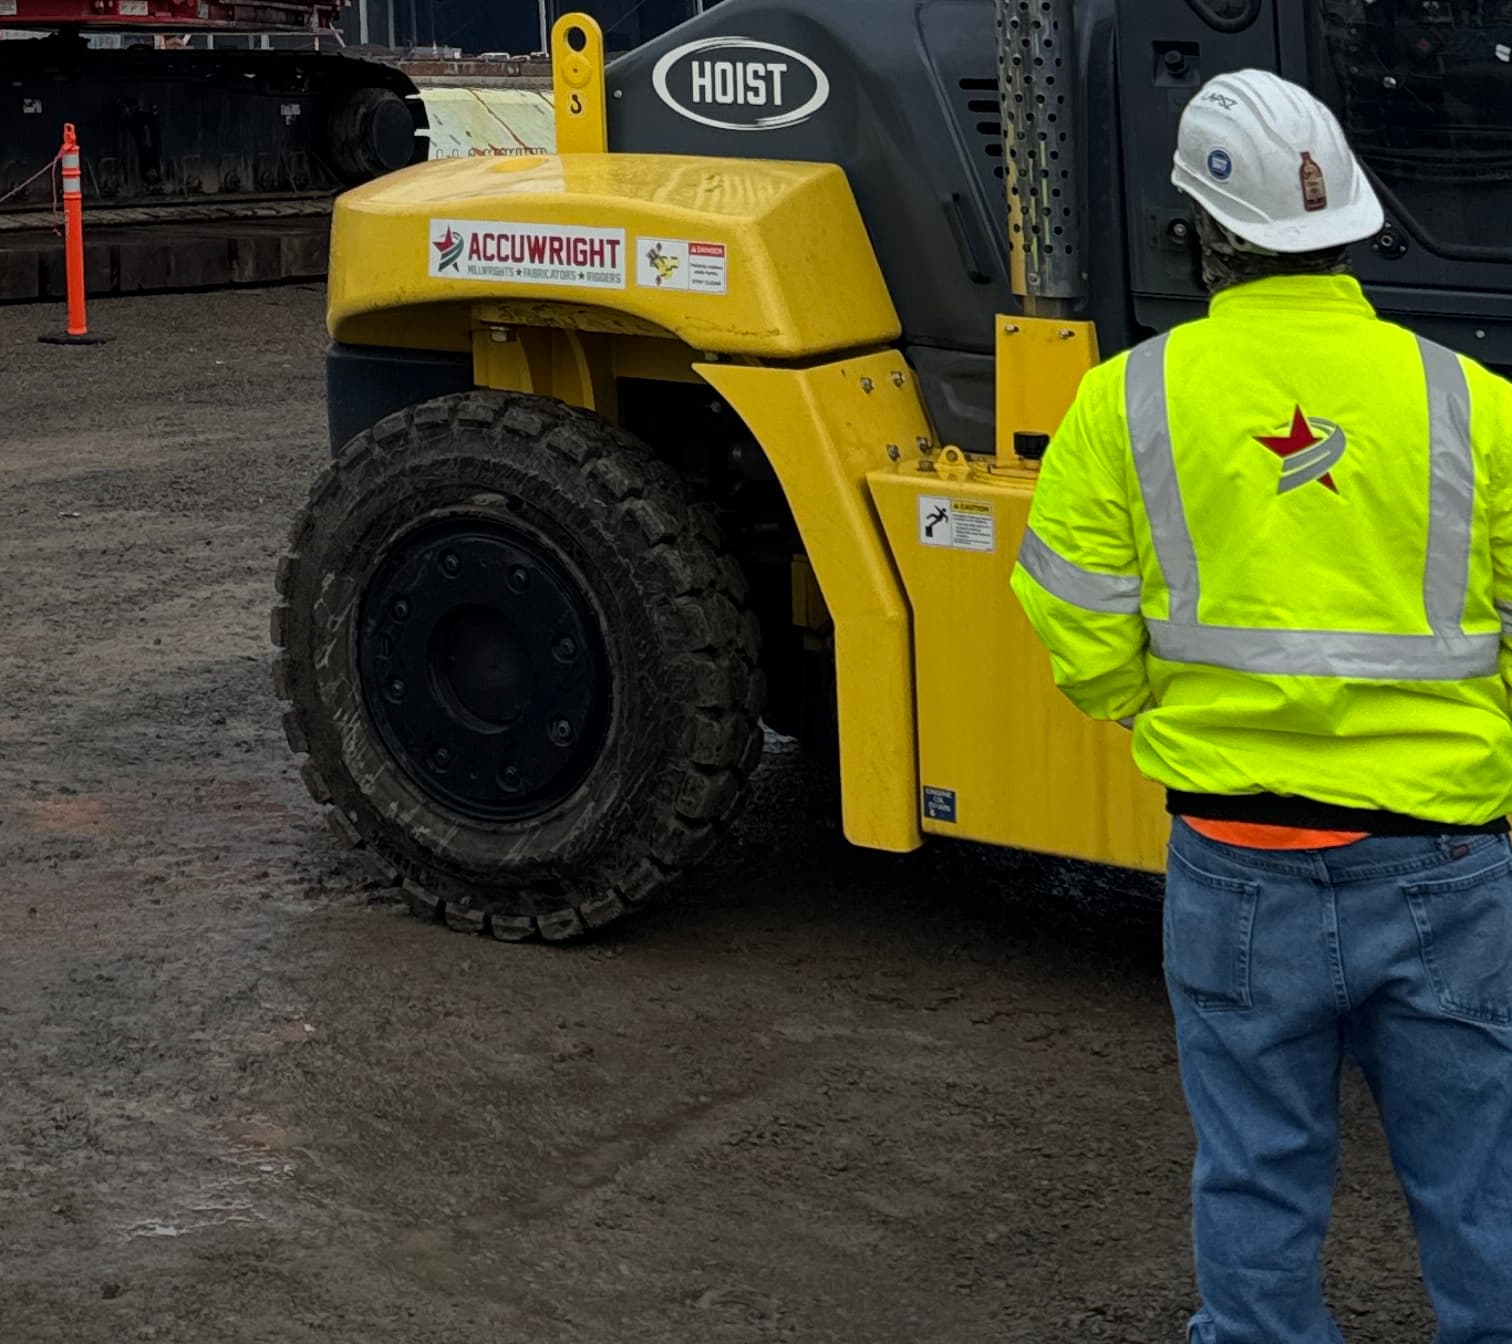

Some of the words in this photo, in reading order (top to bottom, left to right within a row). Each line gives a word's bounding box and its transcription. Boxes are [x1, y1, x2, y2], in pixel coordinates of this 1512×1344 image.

[691, 60, 787, 105] HOIST
[467, 232, 620, 269] ACCUWRIGHT
[523, 268, 576, 281] FABRICATORS
